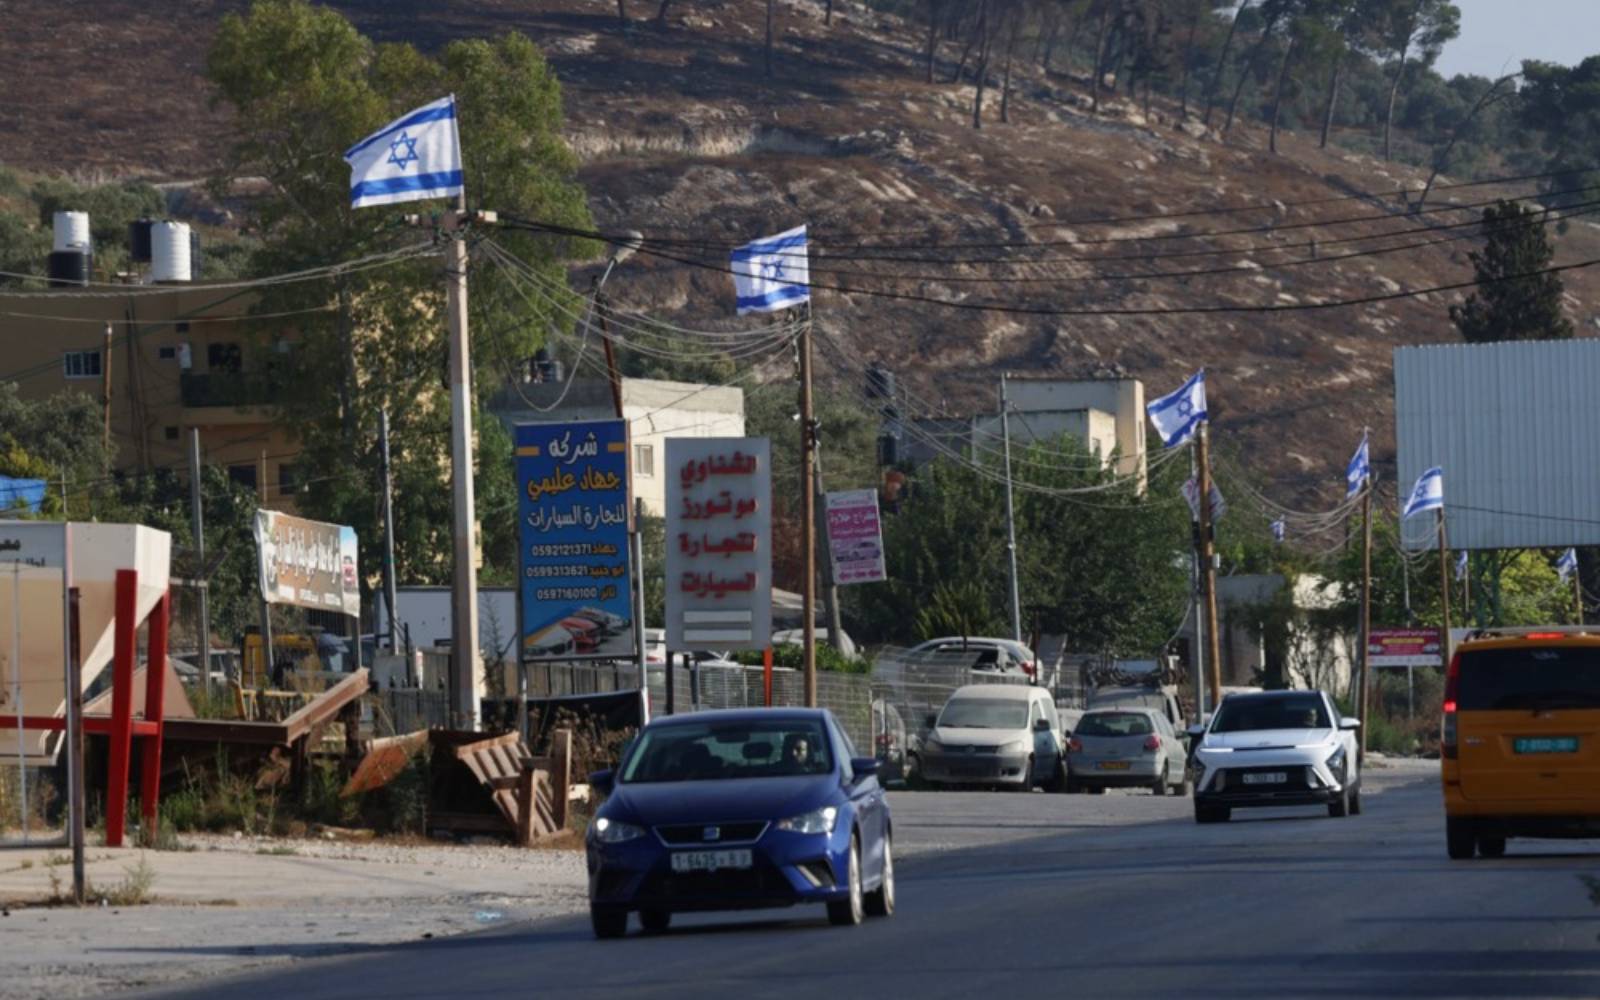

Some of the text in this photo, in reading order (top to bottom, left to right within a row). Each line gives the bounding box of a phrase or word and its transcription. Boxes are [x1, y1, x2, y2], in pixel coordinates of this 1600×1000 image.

[527, 464, 621, 501] جهاد عليمي
[527, 504, 582, 533] السيارات
